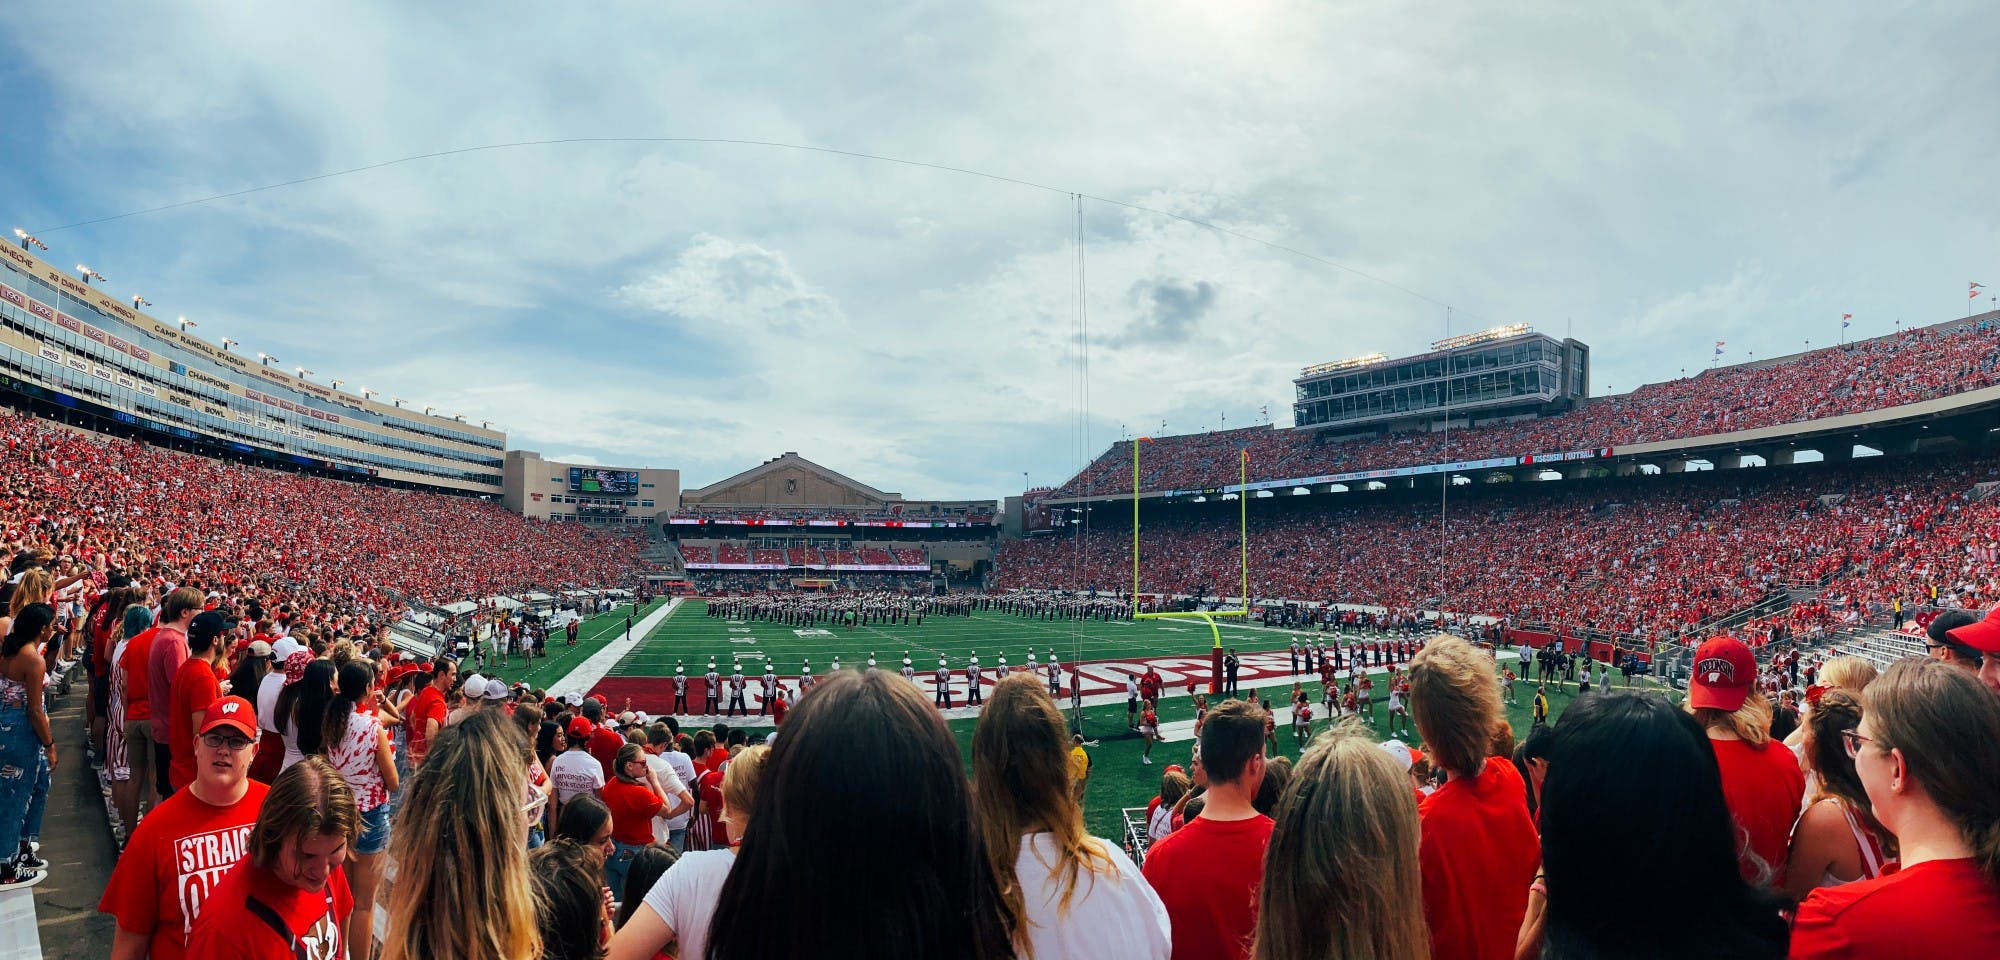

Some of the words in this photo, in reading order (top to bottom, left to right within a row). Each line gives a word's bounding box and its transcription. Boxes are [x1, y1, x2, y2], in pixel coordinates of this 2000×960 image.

[154, 325, 177, 338] CAMP
[180, 335, 214, 355] RANDALL
[217, 351, 246, 368] STADIUM
[43, 349, 59, 361] 1953
[69, 360, 87, 371] 1960
[95, 369, 111, 379] 1963
[188, 370, 230, 391] CHAMPIONS
[169, 396, 191, 407] ROSE
[204, 406, 225, 417] BOWL
[125, 412, 136, 424] THE
[150, 420, 170, 433] DRIVE
[1533, 453, 1563, 464] WISCONSIN
[1565, 449, 1594, 460] FOOTBALL
[222, 702, 239, 714] W
